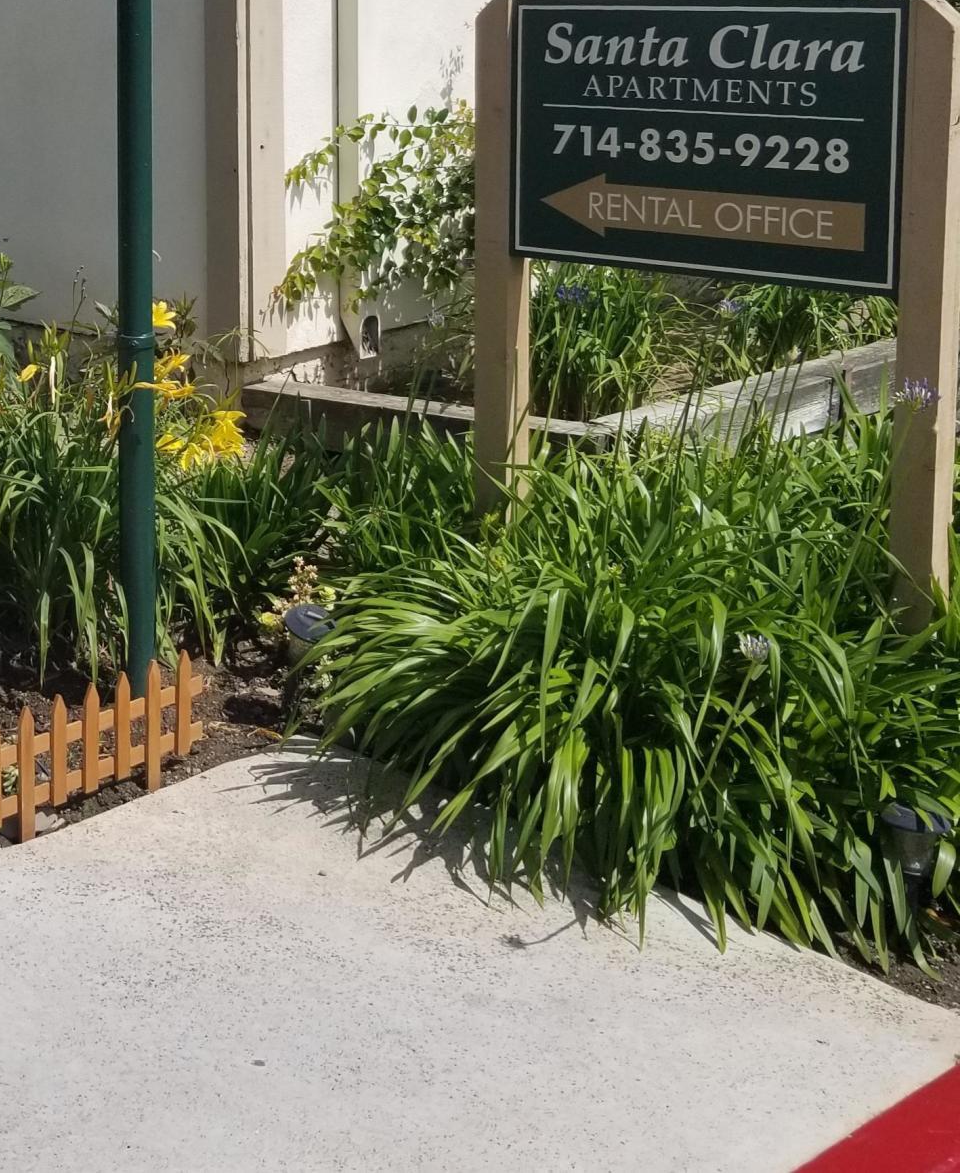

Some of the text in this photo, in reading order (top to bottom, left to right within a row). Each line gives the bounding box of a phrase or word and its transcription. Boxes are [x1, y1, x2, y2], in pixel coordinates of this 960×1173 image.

[544, 22, 865, 73] Santa Clara
[582, 74, 817, 107] APARTMENTS
[553, 124, 849, 174] 714-835-9228
[588, 192, 833, 240] RENTAL OFFICE
